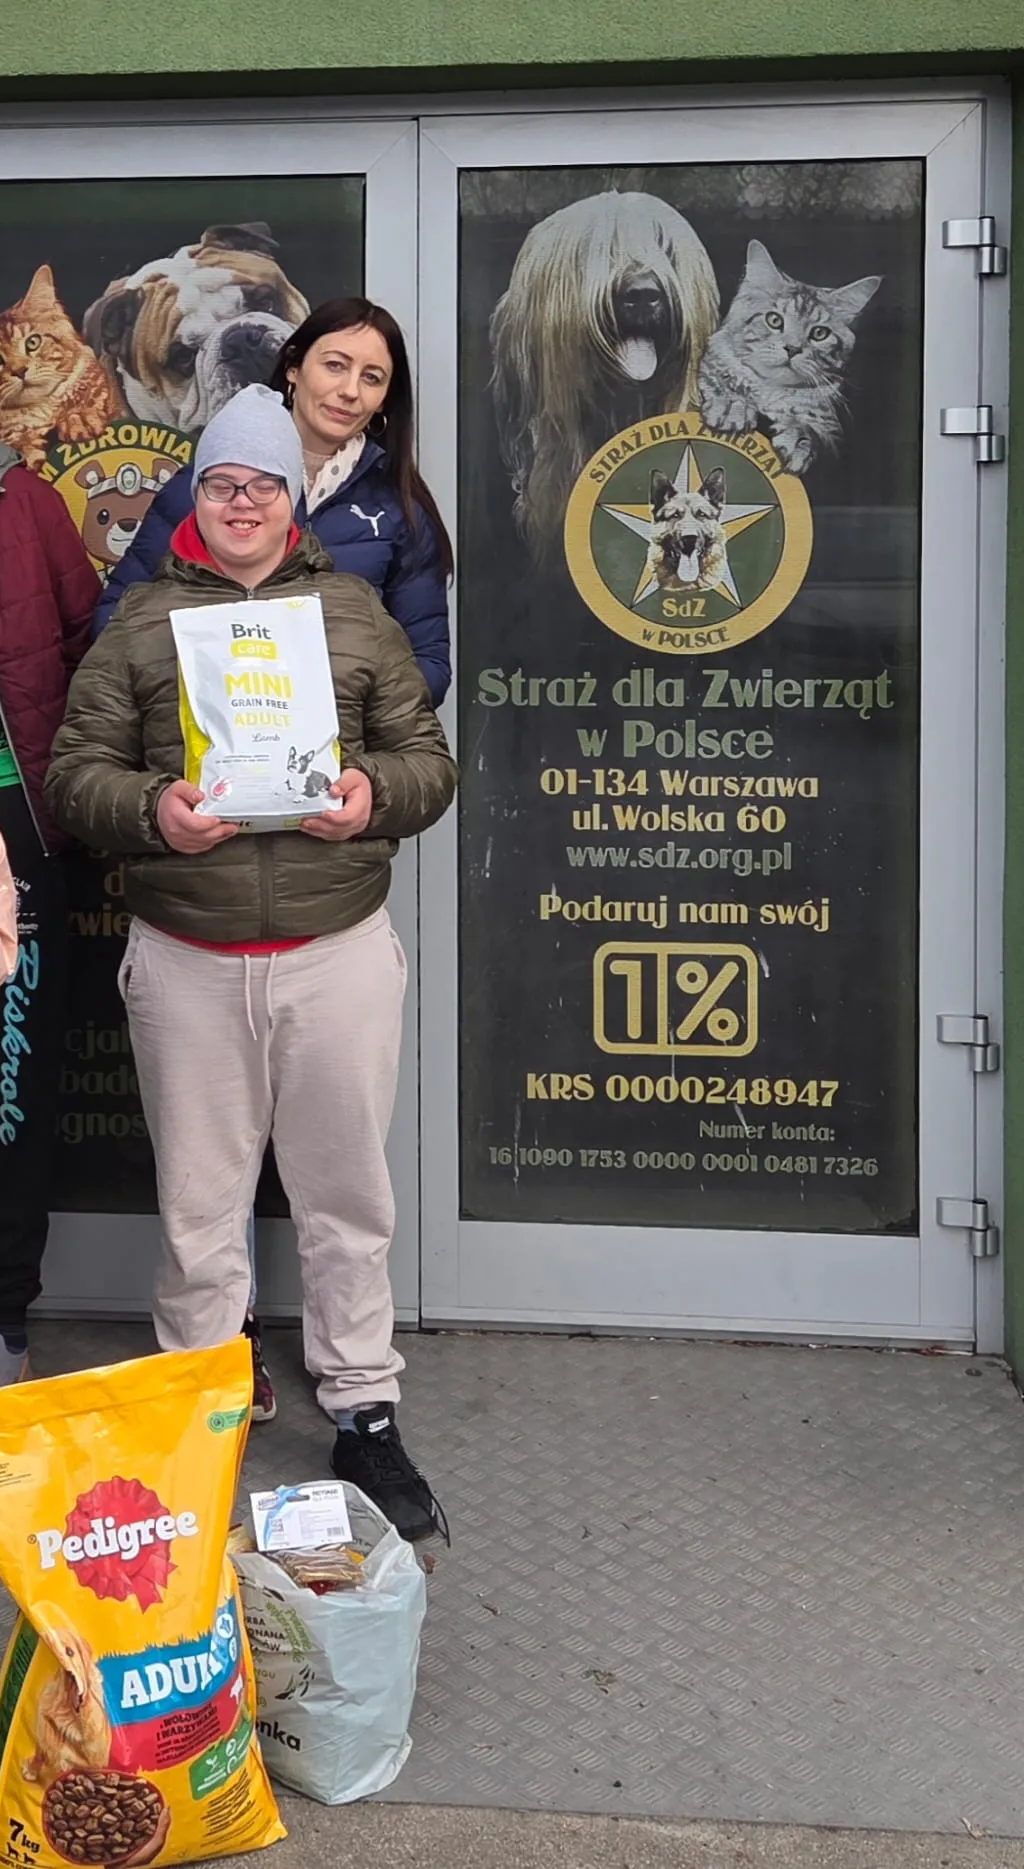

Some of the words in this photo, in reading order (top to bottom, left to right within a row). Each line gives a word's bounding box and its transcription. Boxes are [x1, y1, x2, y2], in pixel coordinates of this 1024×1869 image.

[589, 430, 646, 484] STRAŻ
[649, 419, 689, 442] DLA
[662, 598, 707, 618] SdZ
[230, 623, 272, 640] Brit
[658, 626, 729, 649] POLSCE
[224, 671, 293, 699] MINI
[477, 667, 598, 708] Straż
[612, 667, 686, 708] dla
[702, 668, 895, 720] Zwierząt
[231, 698, 263, 708] GRAIN
[266, 698, 289, 710] FREE
[234, 711, 292, 728] ADULT
[251, 732, 281, 743] Lamb
[577, 727, 608, 758] w
[623, 718, 774, 760] Polsce
[540, 768, 650, 797] 01-134
[660, 769, 820, 799] Warszawa
[572, 803, 609, 832] ul.
[612, 804, 726, 833] Wolska
[736, 804, 787, 834] 60
[566, 841, 793, 877] www.sdz.org.pl
[539, 893, 669, 930] Podaruj
[678, 901, 749, 925] nam
[759, 896, 831, 933] swój
[609, 959, 741, 1043] 1%
[526, 1072, 595, 1102] KRS
[606, 1075, 840, 1108] 0000248947
[698, 1119, 766, 1141] Numer
[771, 1120, 836, 1142] konta:
[489, 1146, 513, 1166] 16
[519, 1147, 574, 1168] 1090
[579, 1148, 627, 1169] 1753
[632, 1150, 696, 1171] 0000
[702, 1152, 760, 1172] 0001
[764, 1153, 817, 1175] 0481
[823, 1155, 879, 1178] 7326
[35, 1511, 200, 1570] Pedigree
[256, 1720, 302, 1752] nka
[9, 1817, 25, 1842] 7
[21, 1833, 41, 1853] kg
